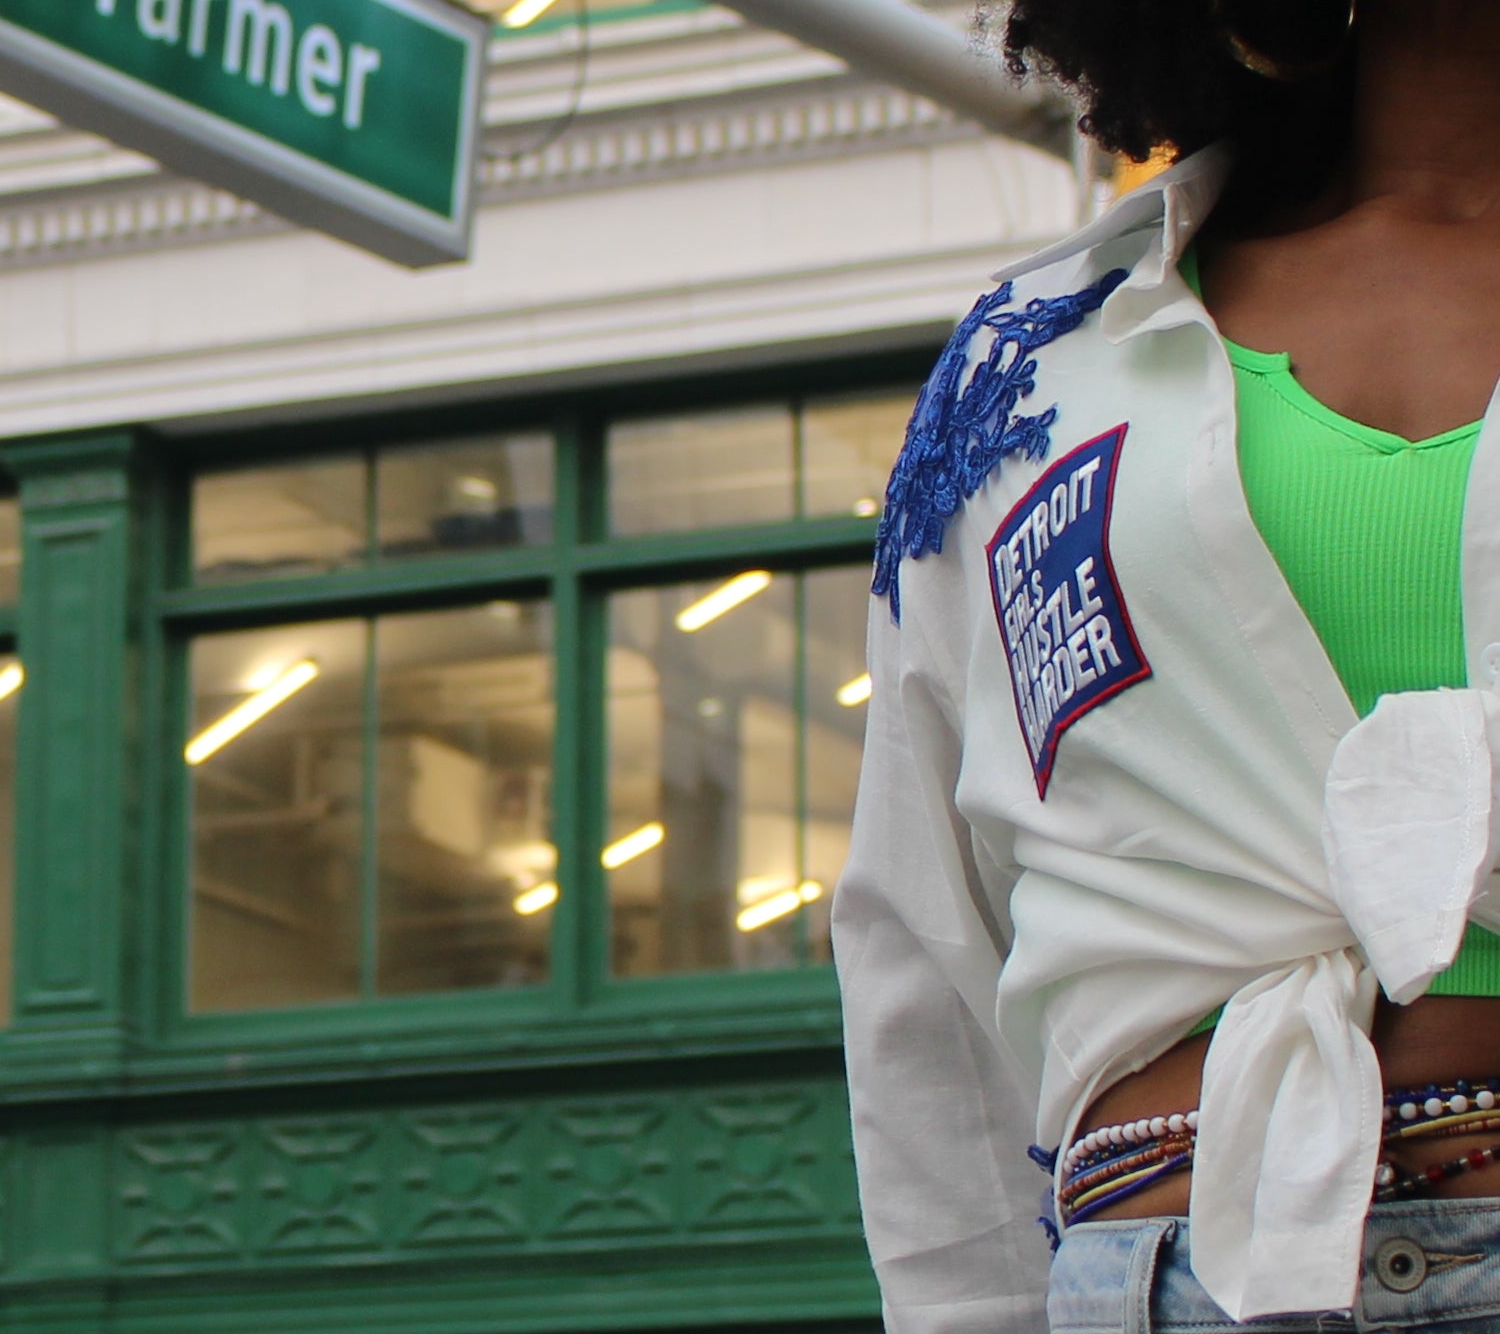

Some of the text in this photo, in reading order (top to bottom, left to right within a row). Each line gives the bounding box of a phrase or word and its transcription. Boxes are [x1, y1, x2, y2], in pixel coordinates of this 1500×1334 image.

[994, 455, 1101, 610] DETROIT
[1004, 569, 1044, 651] GIRLS
[1012, 556, 1103, 707] HUSTLE
[1021, 615, 1123, 764] HARDER
